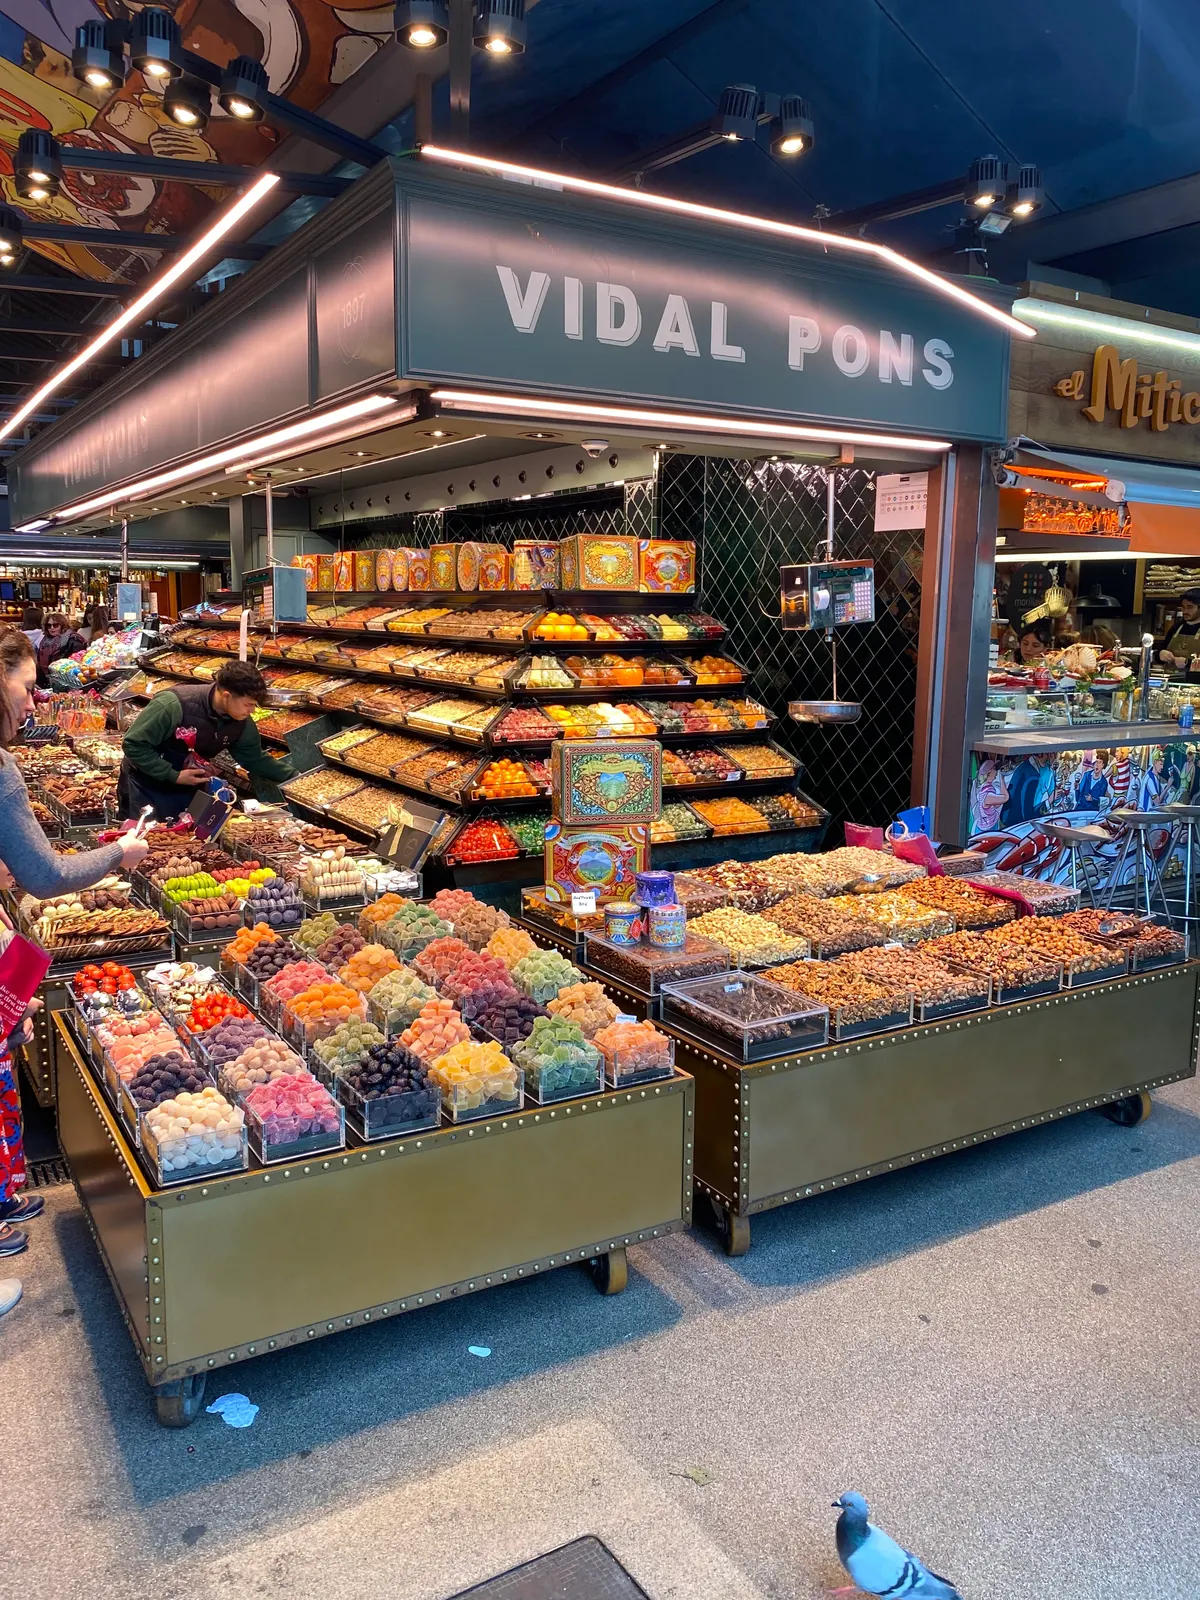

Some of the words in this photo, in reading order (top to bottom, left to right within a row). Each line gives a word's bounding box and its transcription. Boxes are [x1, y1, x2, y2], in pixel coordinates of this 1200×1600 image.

[342, 293, 366, 329] 1897
[495, 264, 746, 364] VIDAL
[787, 314, 955, 391] PONS
[1053, 370, 1085, 401] el
